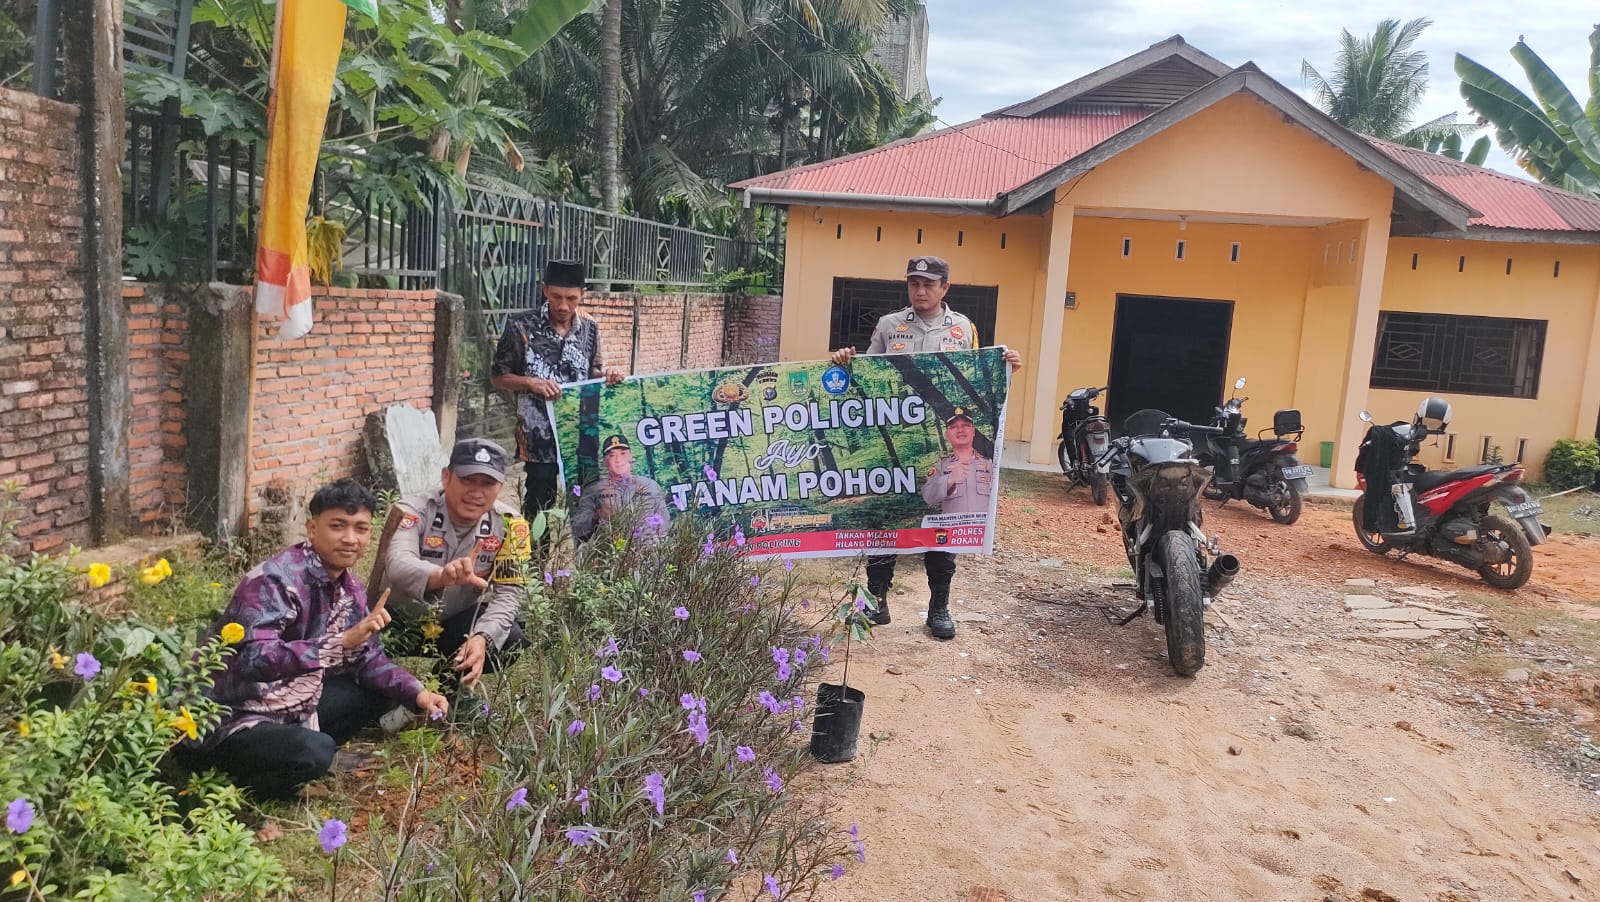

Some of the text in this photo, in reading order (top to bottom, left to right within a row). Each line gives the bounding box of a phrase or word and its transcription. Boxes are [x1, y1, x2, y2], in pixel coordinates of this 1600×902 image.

[636, 395, 926, 446] GREEN POLICING
[753, 439, 828, 470] Ayo
[670, 466, 917, 512] TANAM POHON
[835, 531, 899, 540] TAKKAN MELAYU
[952, 527, 983, 536] POLRES
[756, 538, 802, 552] POLICING
[835, 540, 865, 548] HILANG
[951, 537, 979, 545] ROKAN
